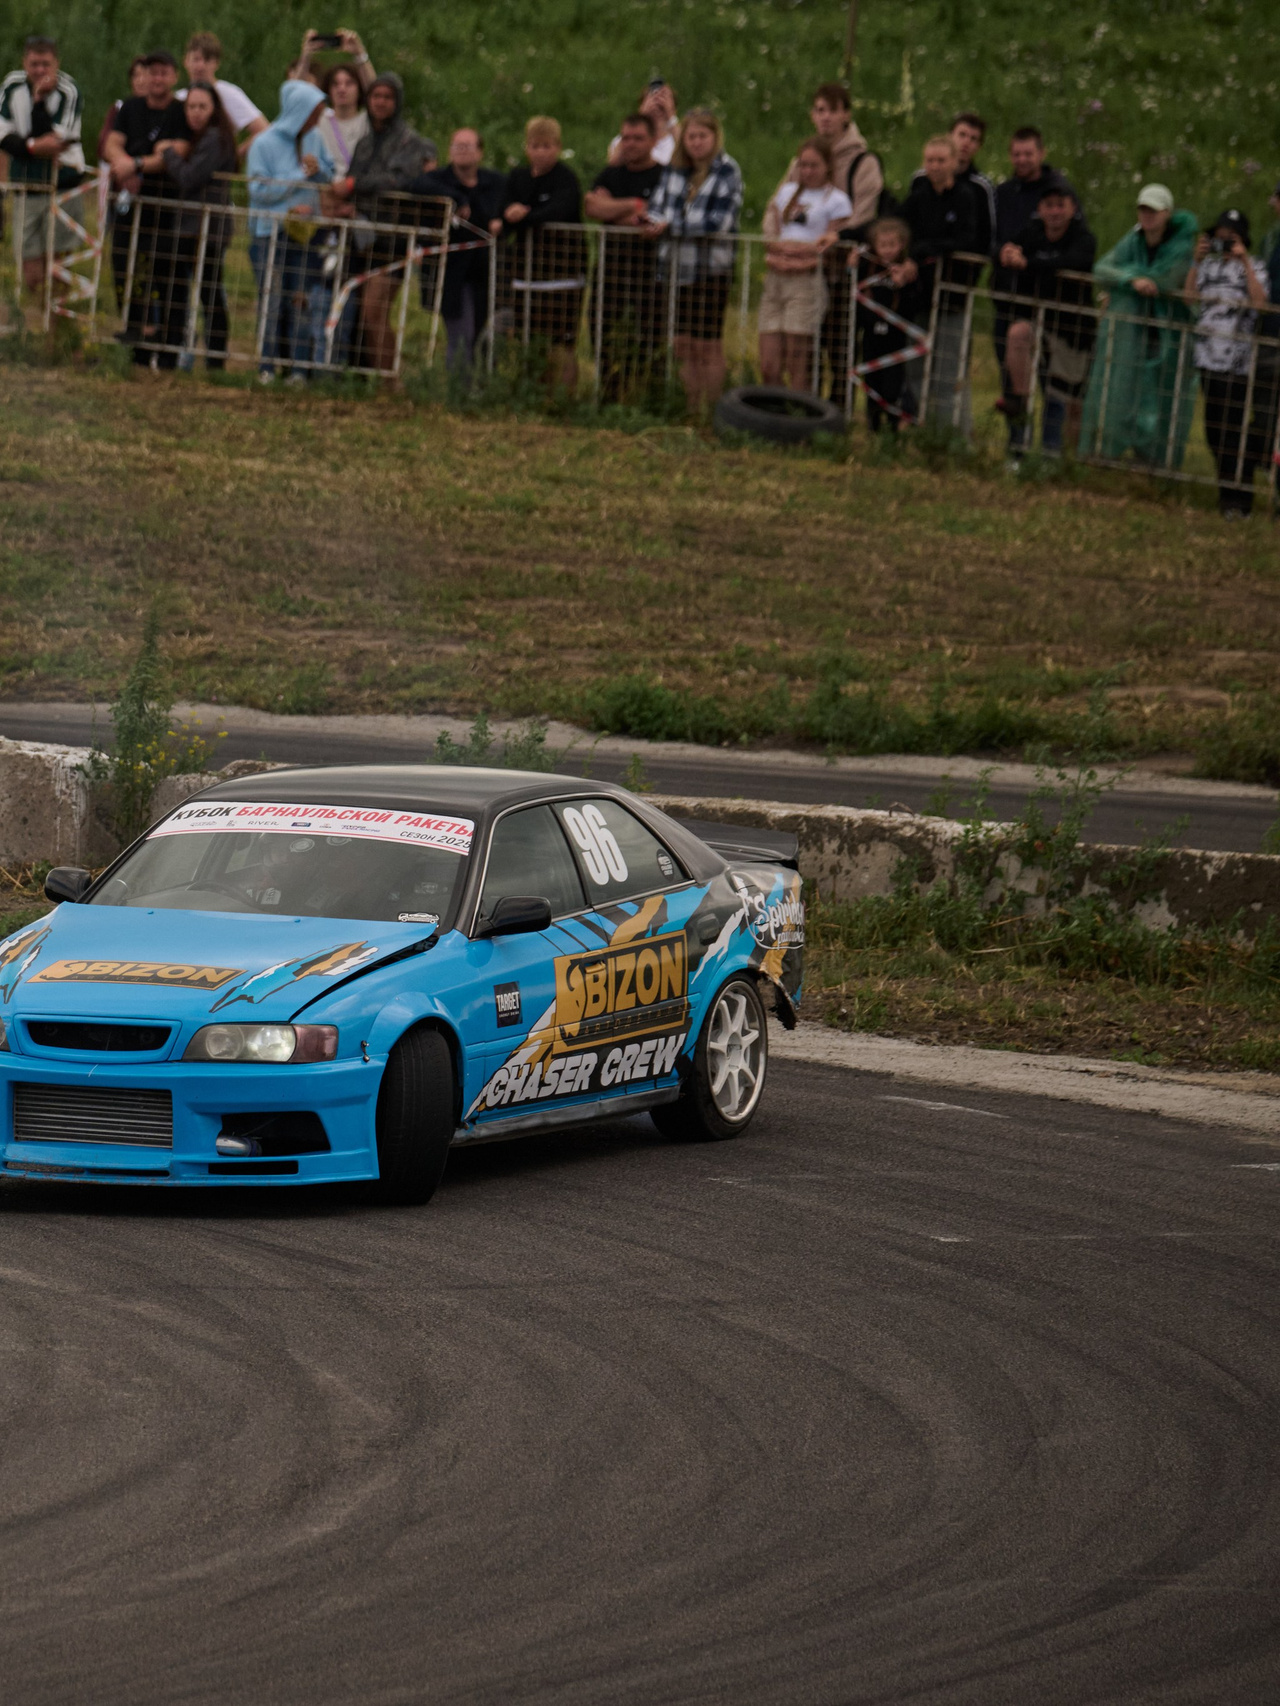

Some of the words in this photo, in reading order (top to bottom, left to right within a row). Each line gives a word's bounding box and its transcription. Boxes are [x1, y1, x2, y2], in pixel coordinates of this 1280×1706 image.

[171, 806, 237, 821] КУБОК
[235, 806, 395, 824] БАРНАУЛЬСКОЙ
[400, 830, 436, 841] СЕЗОН
[437, 835, 471, 849] 2025
[563, 804, 628, 885] 96
[79, 961, 235, 983] BIZON
[583, 941, 683, 1019] BIZON
[496, 991, 520, 1012] TARGET
[486, 1052, 598, 1107] CHASER
[600, 1033, 687, 1087] CREW
